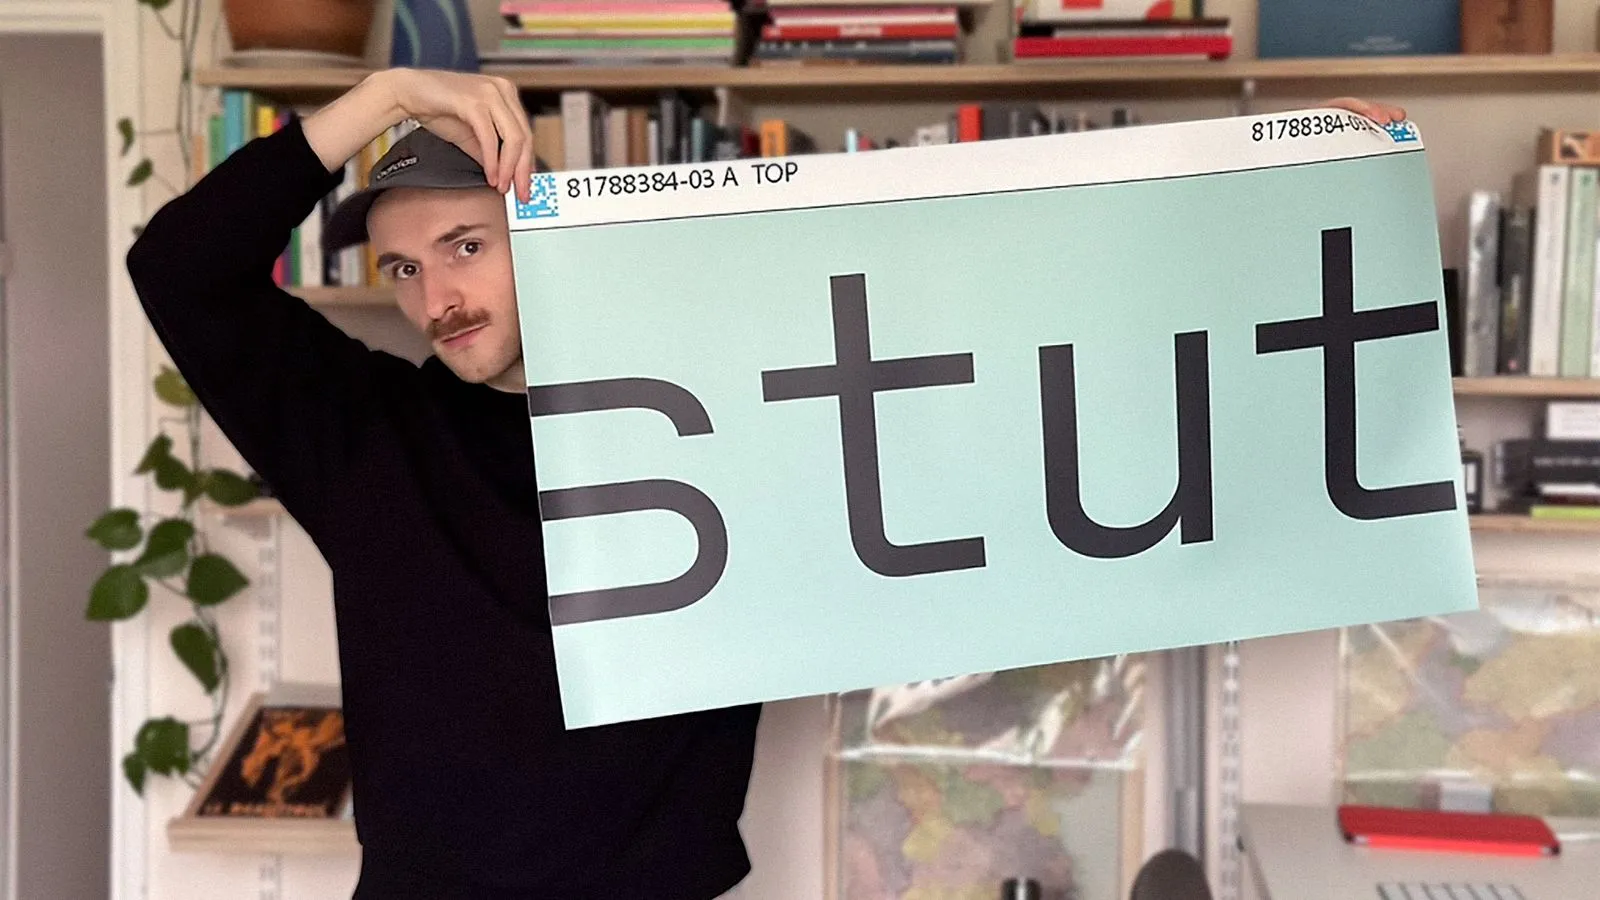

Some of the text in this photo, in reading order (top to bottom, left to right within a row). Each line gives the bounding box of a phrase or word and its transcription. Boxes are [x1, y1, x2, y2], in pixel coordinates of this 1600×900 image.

[566, 161, 798, 198] 81788384-03 A TOP
[527, 226, 1457, 627] stut
